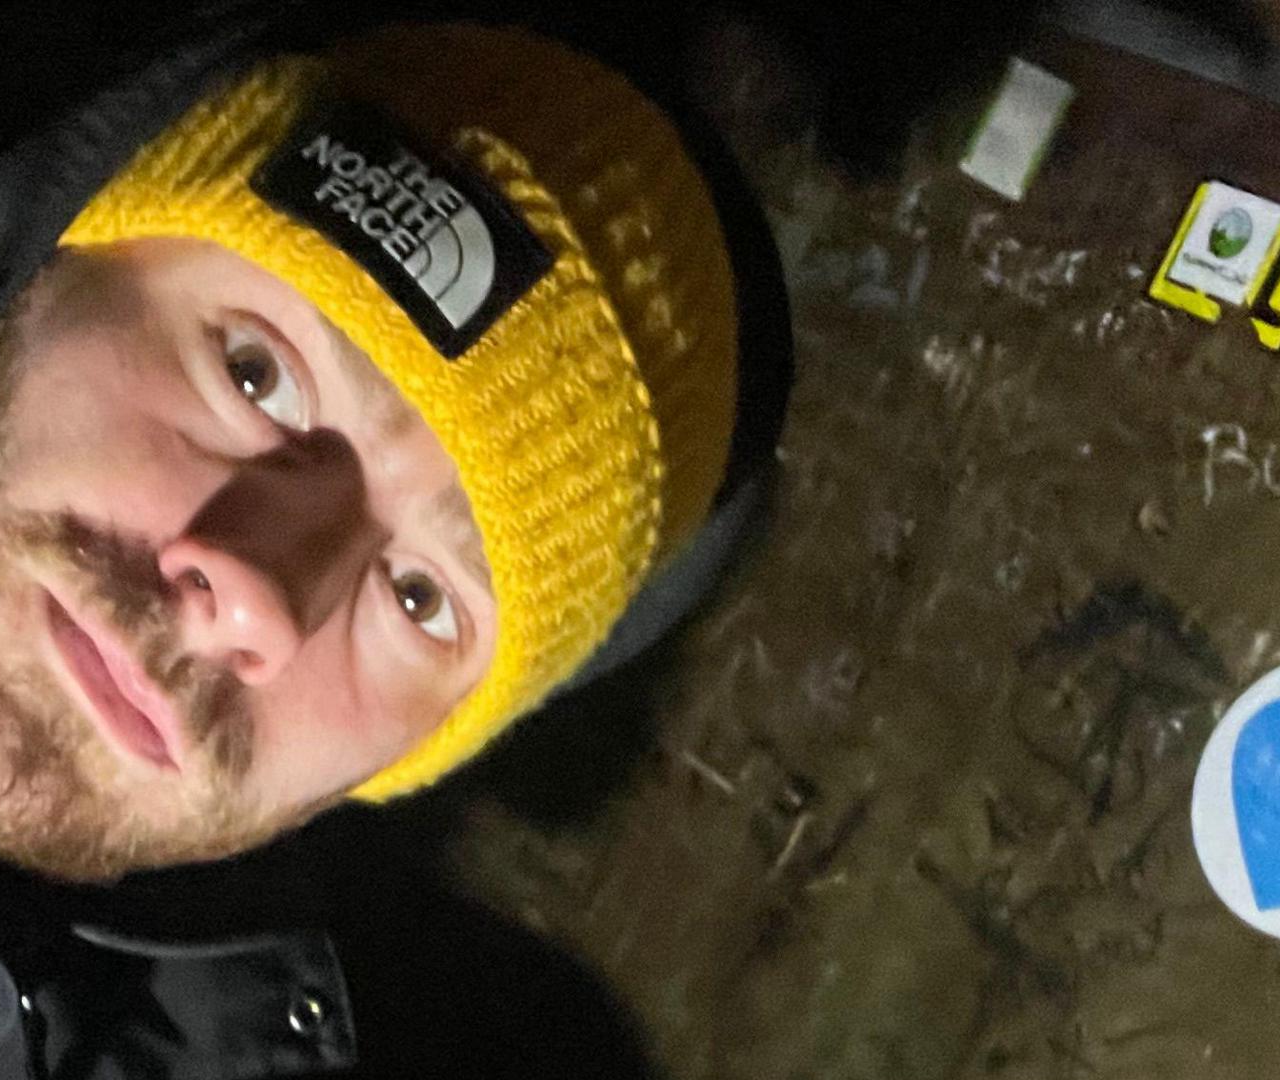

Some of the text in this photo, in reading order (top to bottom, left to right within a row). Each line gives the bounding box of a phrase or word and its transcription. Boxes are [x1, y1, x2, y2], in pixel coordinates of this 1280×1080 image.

[302, 134, 450, 239] NORTH
[314, 176, 420, 261] FACE
[388, 150, 467, 217] THE
